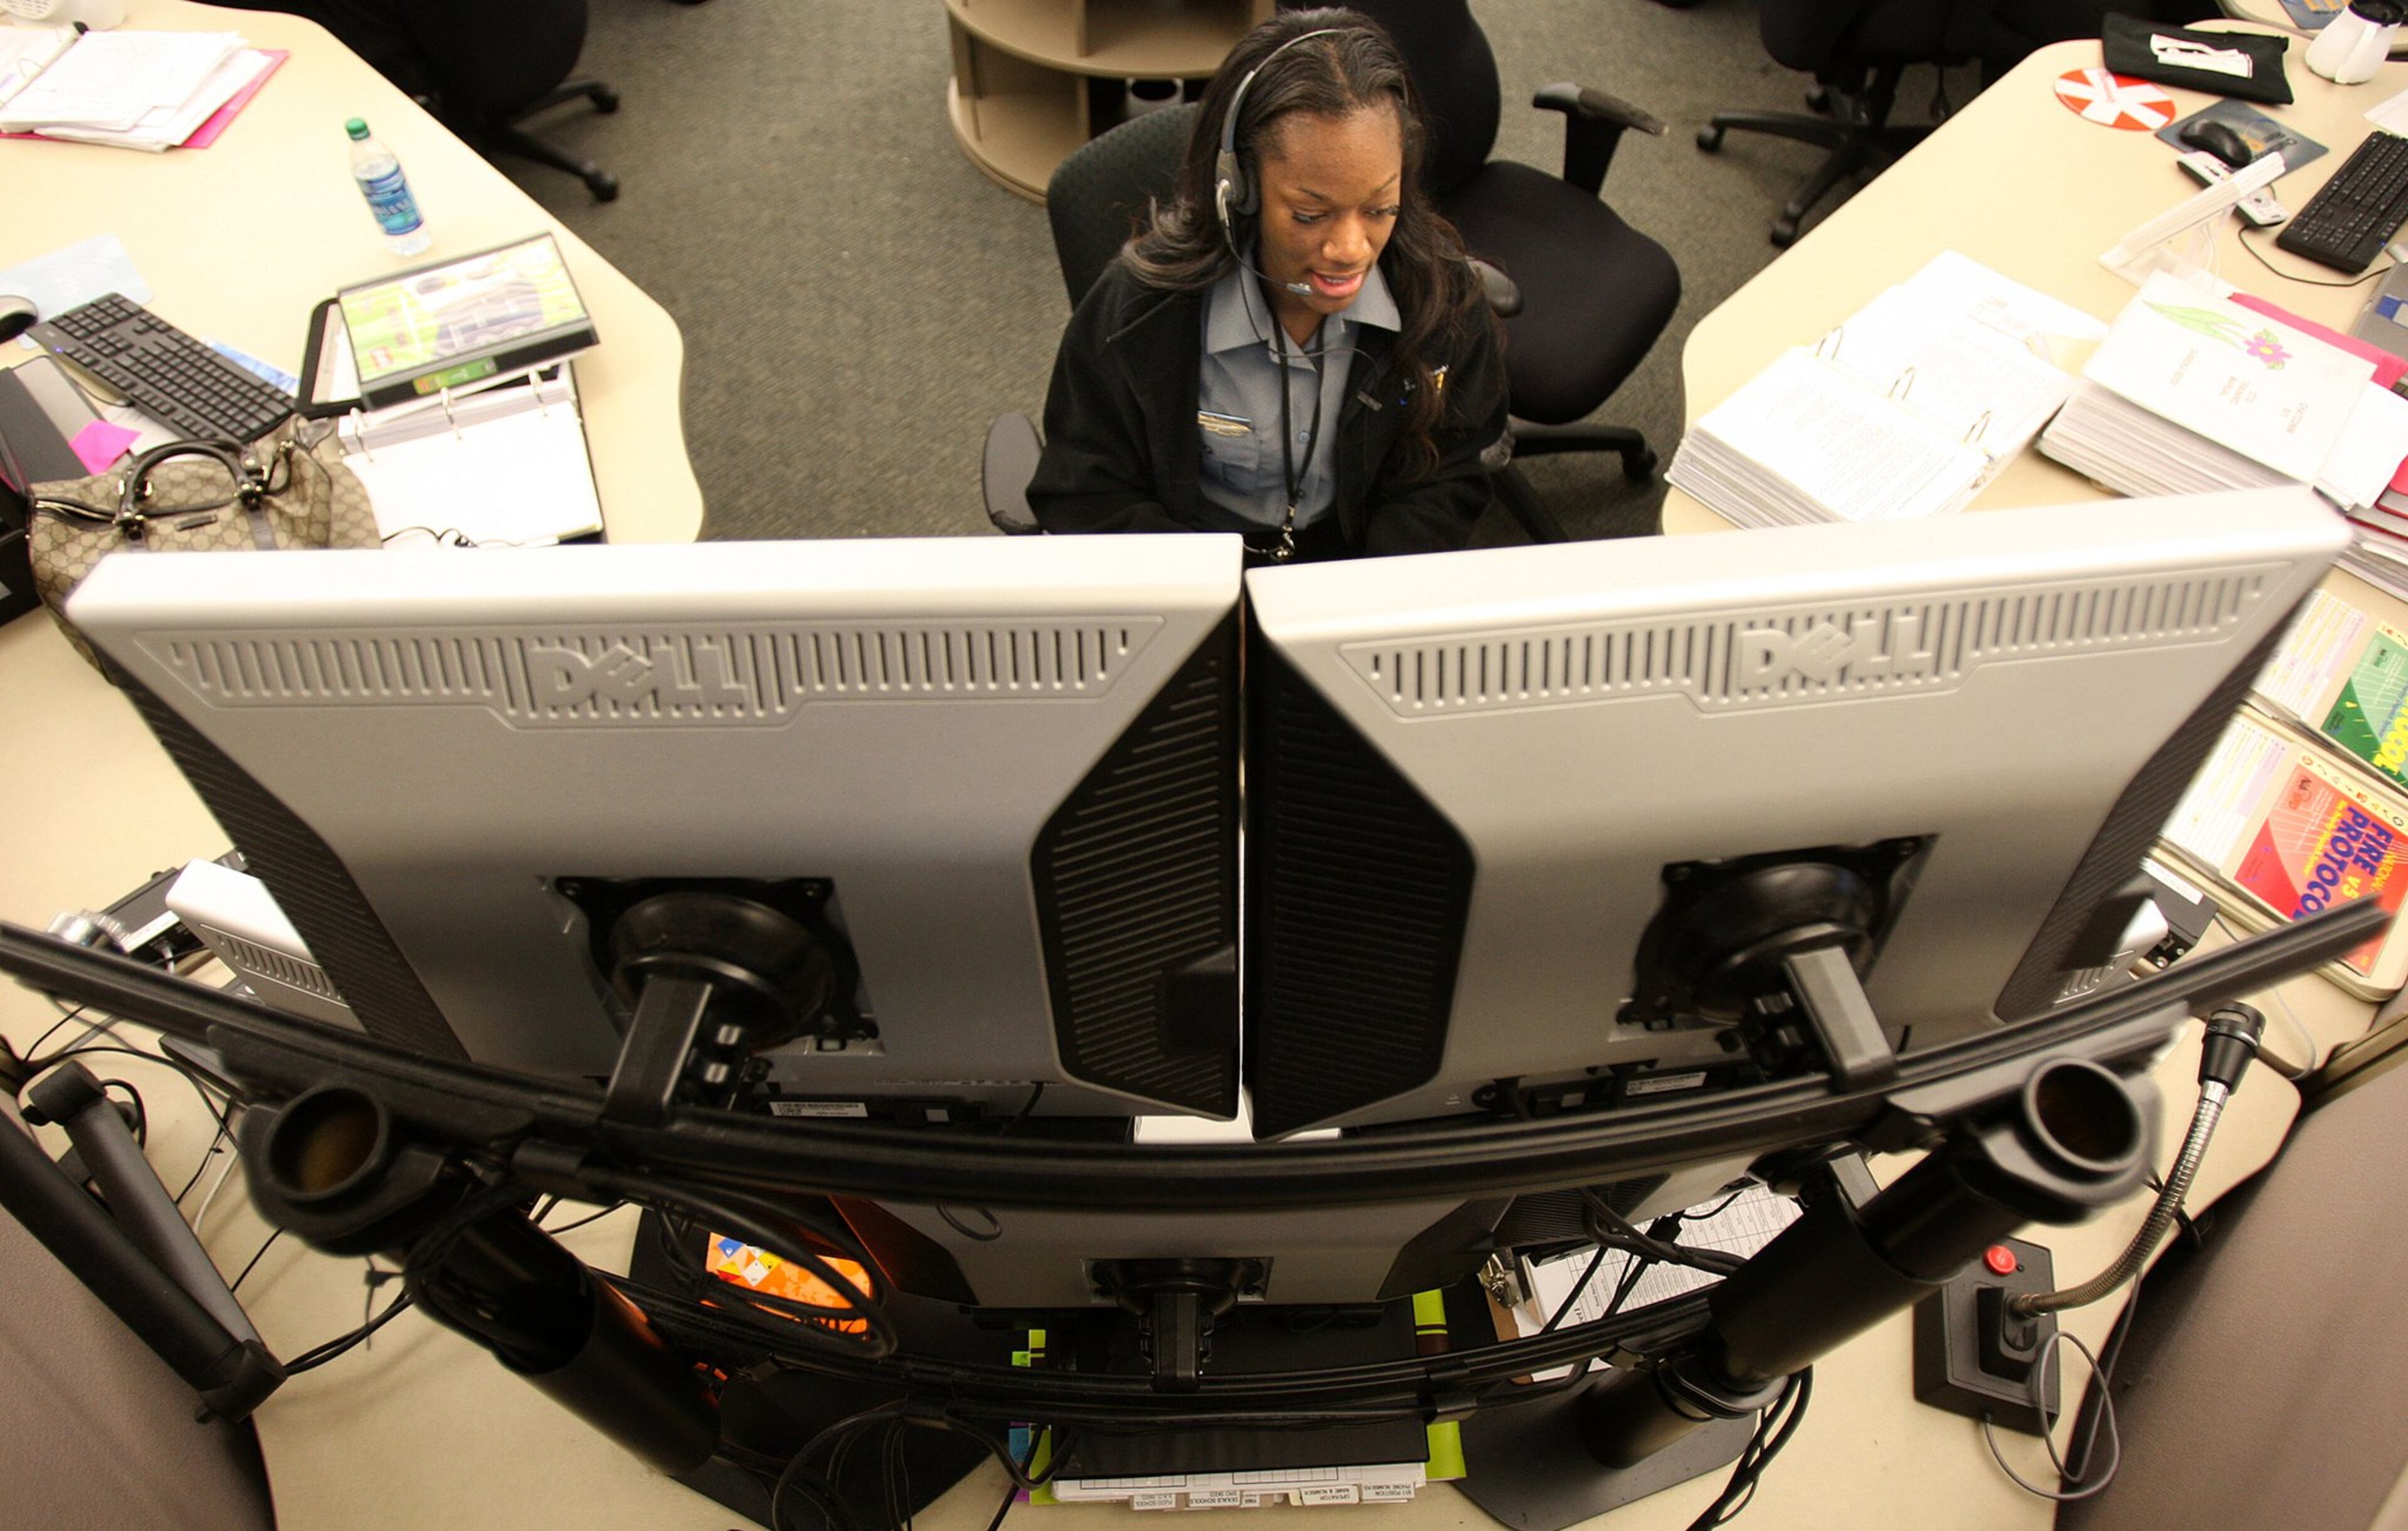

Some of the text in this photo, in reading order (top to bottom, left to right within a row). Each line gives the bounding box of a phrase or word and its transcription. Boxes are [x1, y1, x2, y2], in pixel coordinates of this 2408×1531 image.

[529, 644, 748, 706] DELL
[1738, 616, 1932, 687] DELL
[2373, 696, 2408, 775] OCOL
[2342, 822, 2394, 899] FIRE v5
